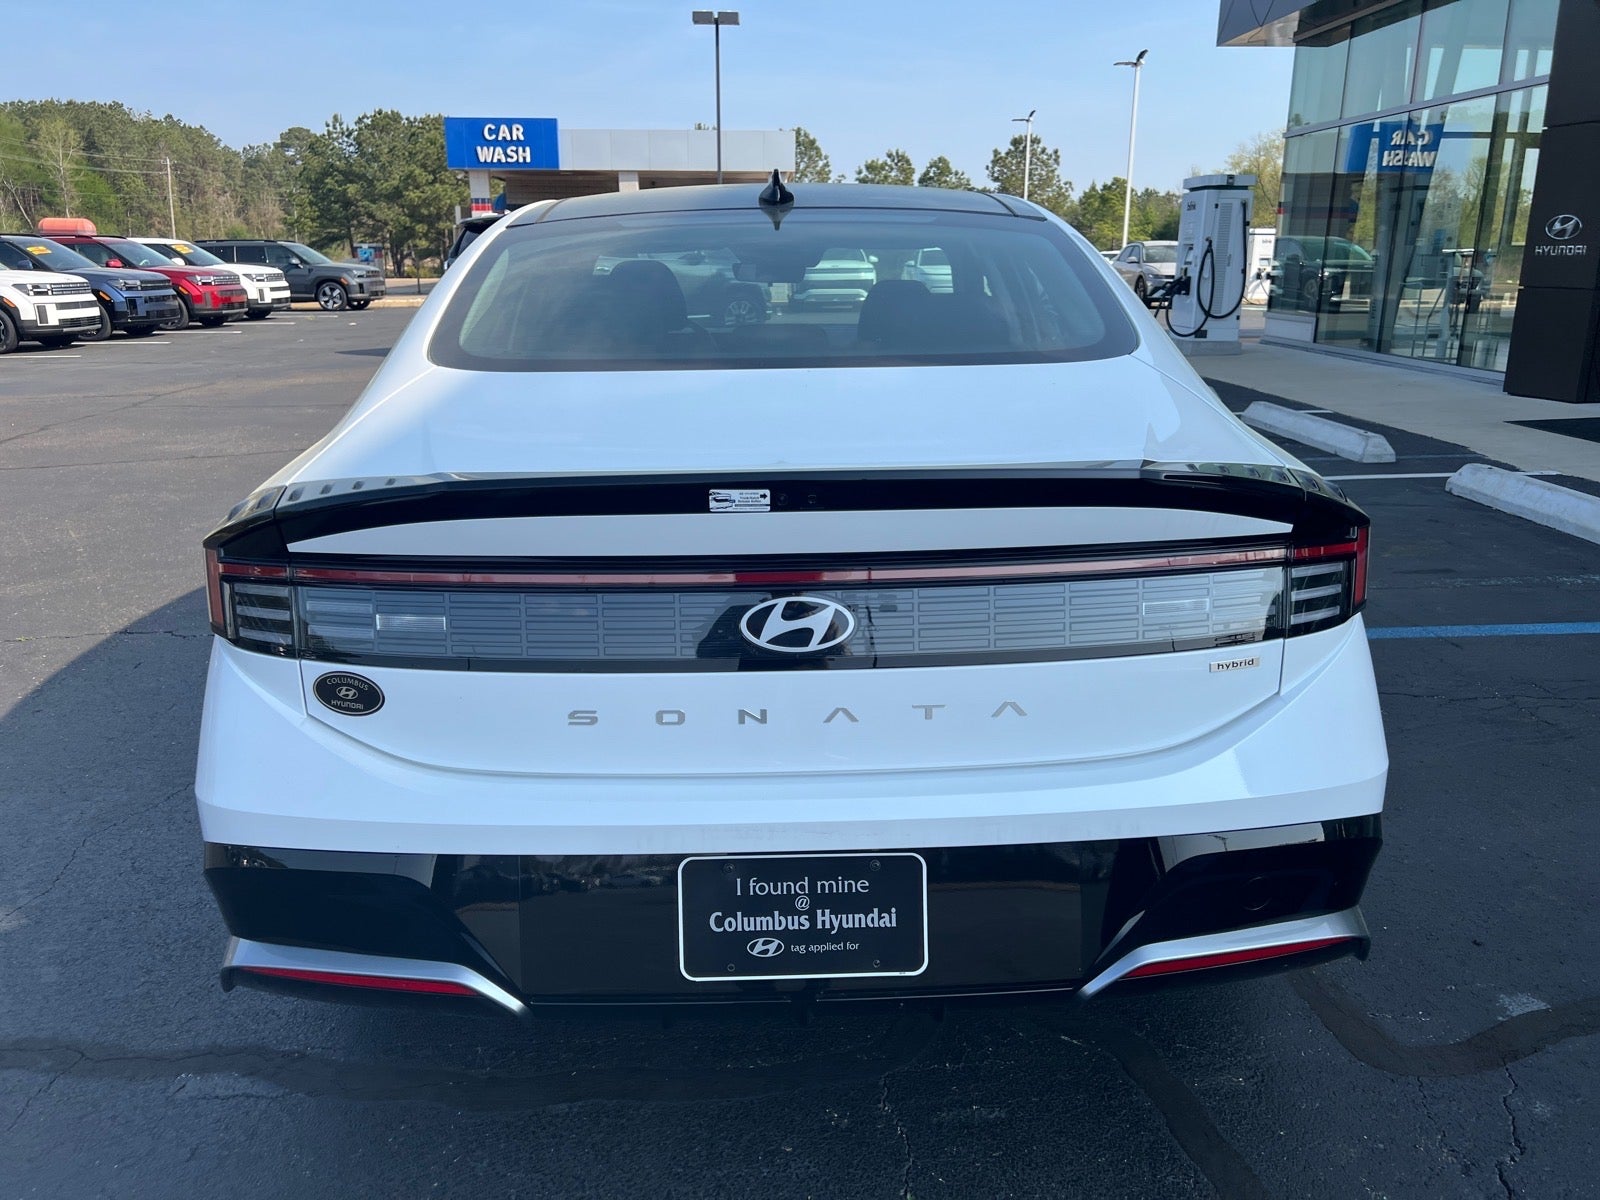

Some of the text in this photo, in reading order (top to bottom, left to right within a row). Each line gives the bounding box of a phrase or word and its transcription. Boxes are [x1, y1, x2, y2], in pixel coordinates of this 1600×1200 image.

[483, 123, 525, 141] CAR
[476, 146, 531, 163] WASH
[1535, 245, 1587, 256] HYUNDAI
[1217, 658, 1254, 670] hybrid
[326, 677, 369, 691] COLUMBUS
[331, 699, 364, 710] HYUNDAI
[567, 700, 1028, 726] SONATA
[736, 876, 870, 896] I found mine
[795, 895, 810, 911] @
[709, 907, 897, 934] Columbus Hyundai
[790, 941, 860, 954] tag applied for
